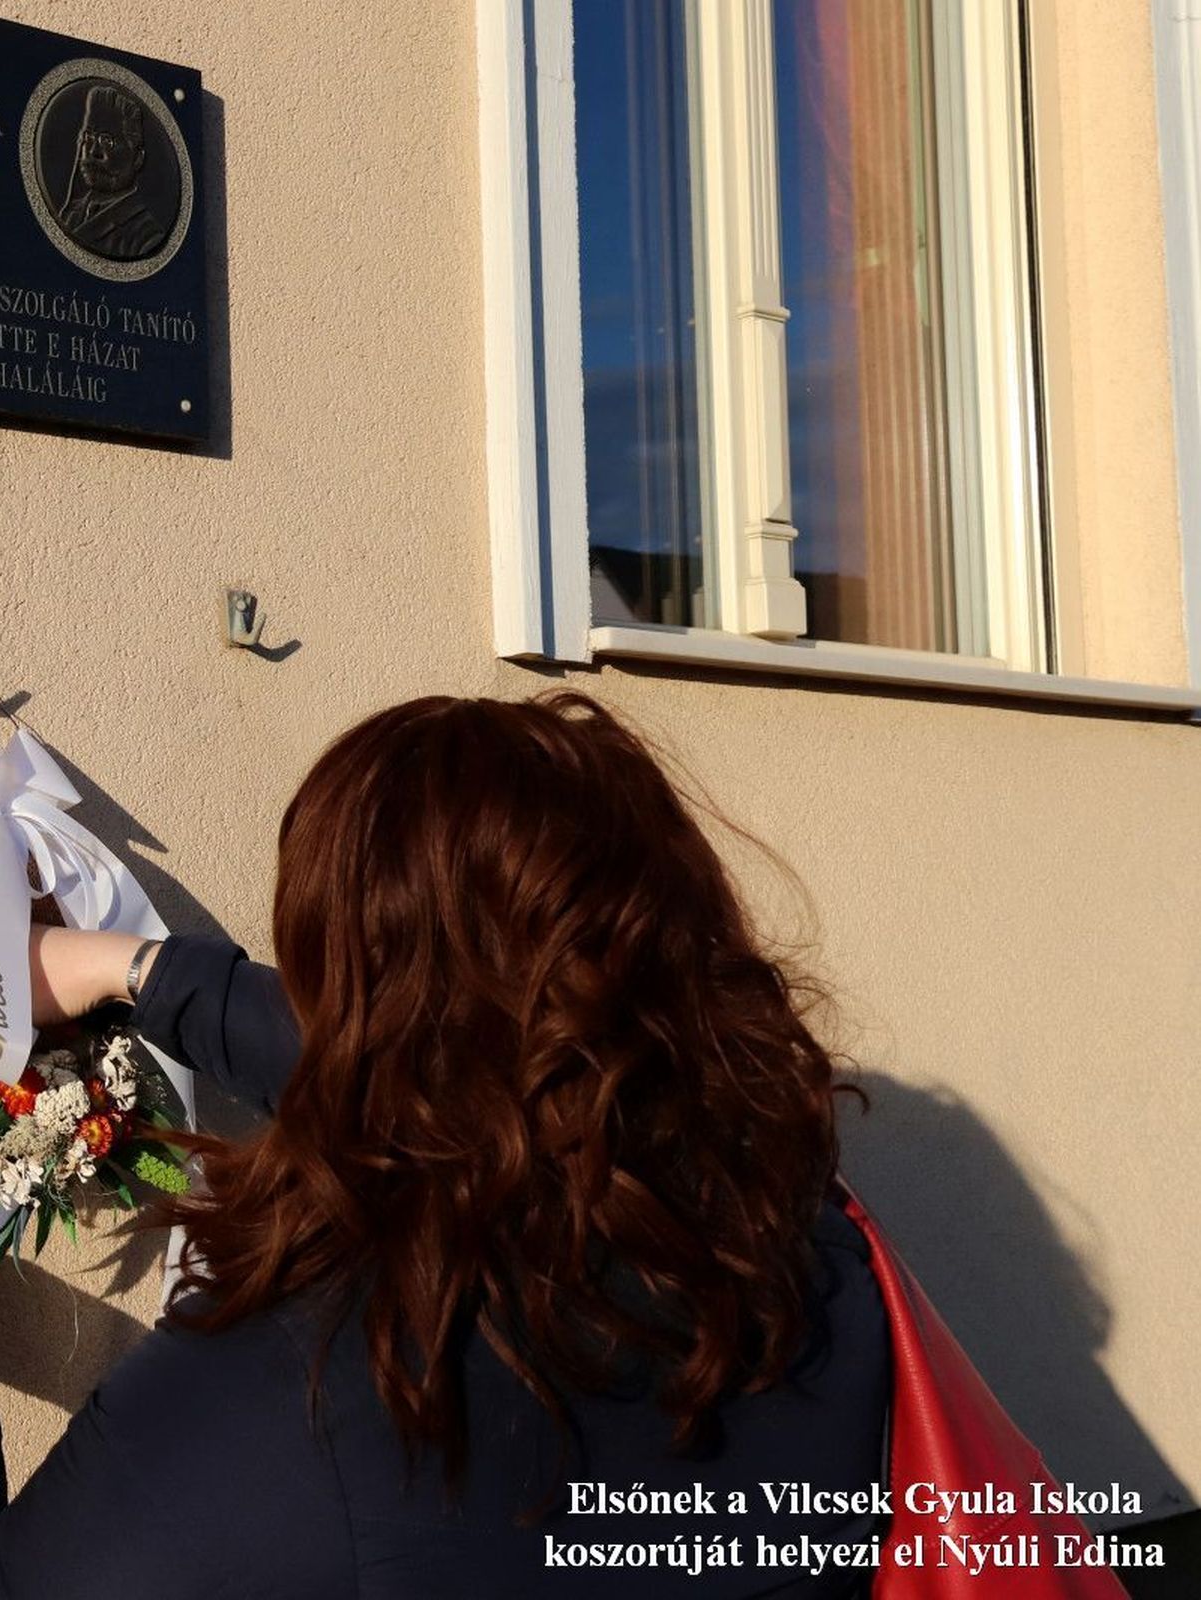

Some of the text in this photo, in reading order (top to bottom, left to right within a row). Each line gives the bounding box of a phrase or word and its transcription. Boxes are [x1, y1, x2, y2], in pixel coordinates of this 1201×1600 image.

[0, 284, 111, 330] SZOLGÁLÓ
[119, 306, 196, 345] TANÍTÓ
[48, 332, 60, 358] E
[70, 330, 141, 371] HÁZAT
